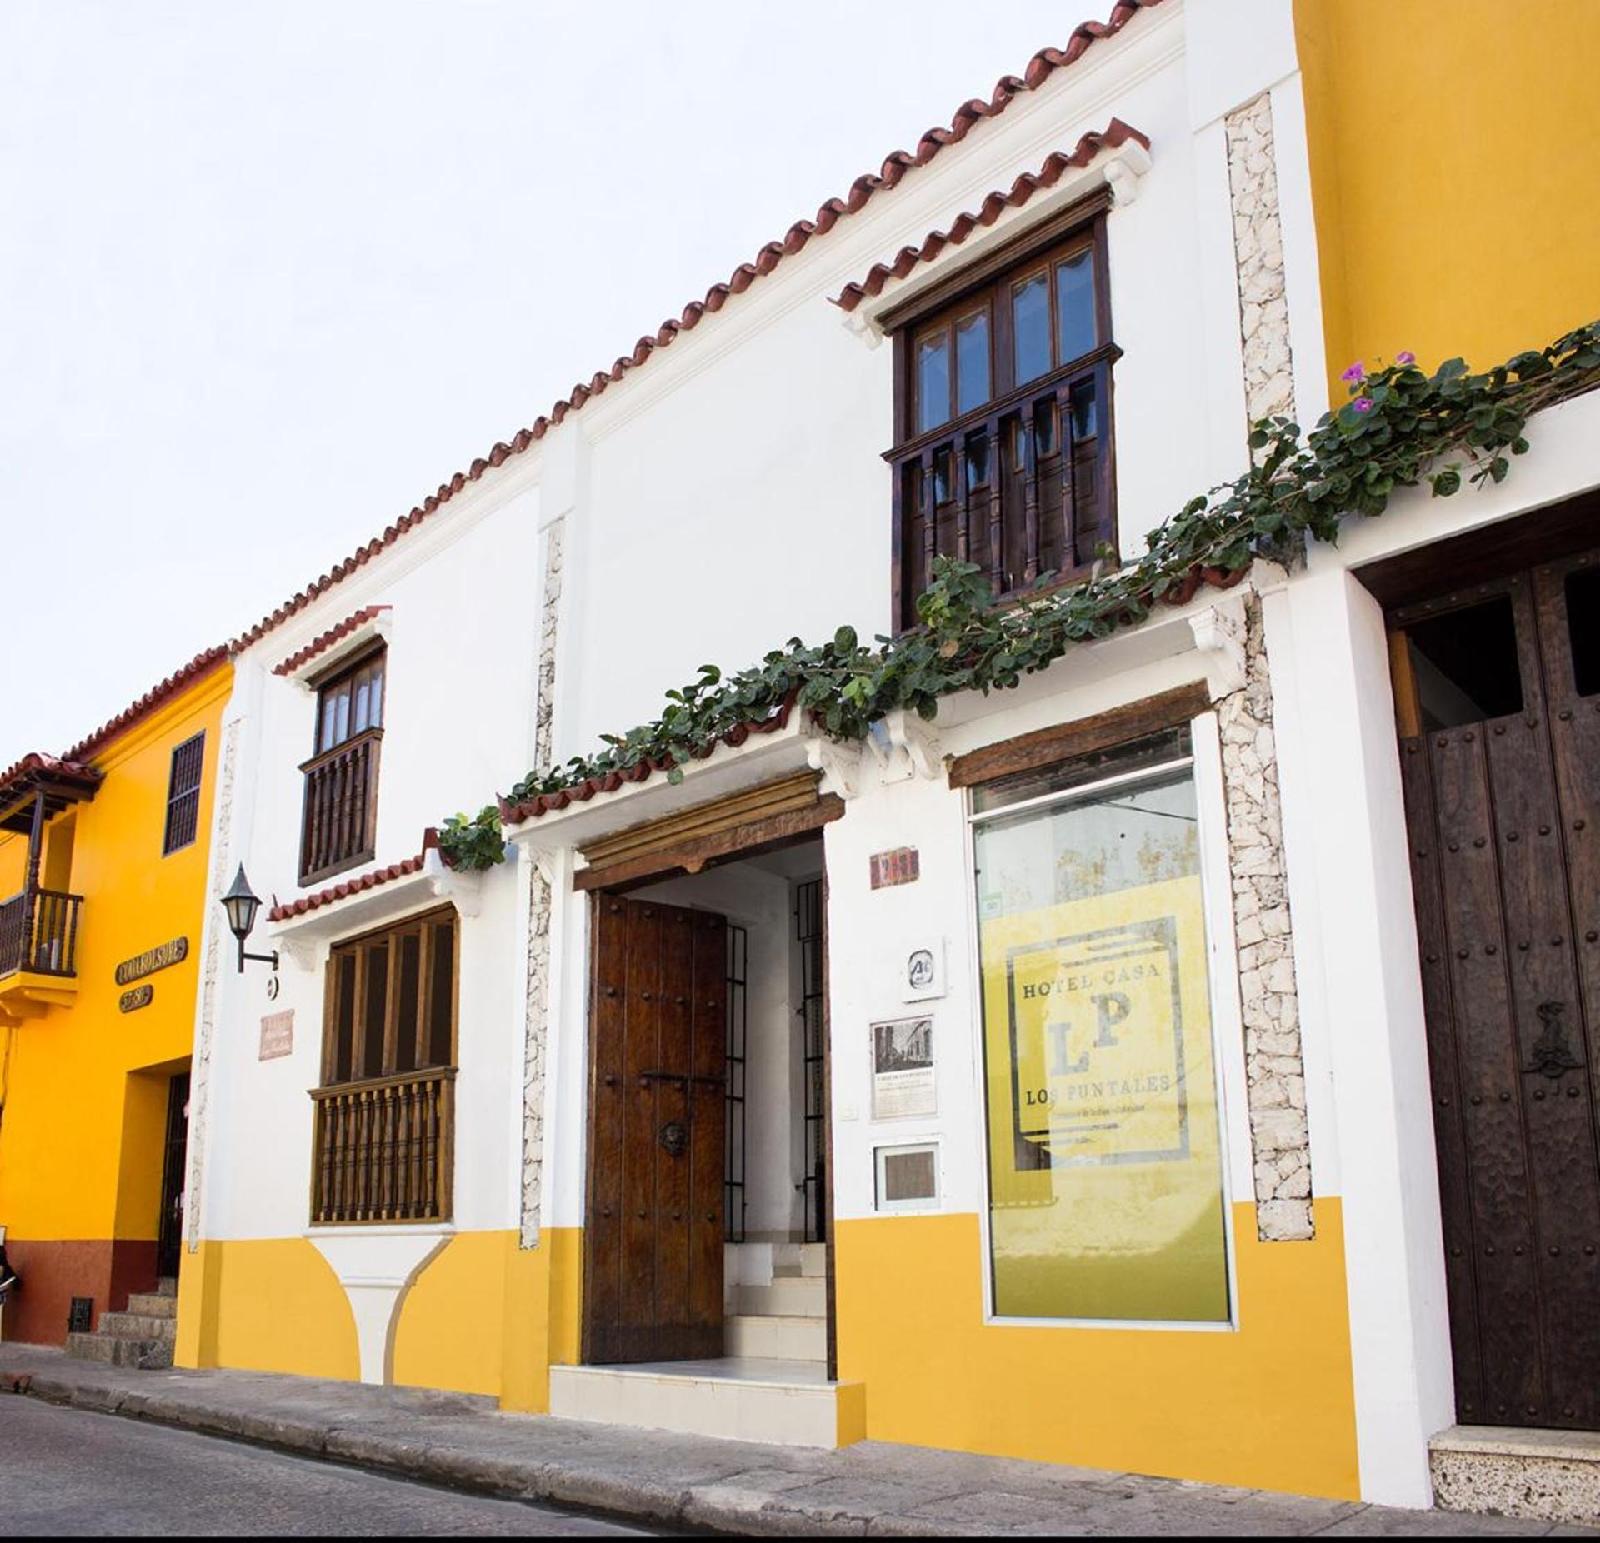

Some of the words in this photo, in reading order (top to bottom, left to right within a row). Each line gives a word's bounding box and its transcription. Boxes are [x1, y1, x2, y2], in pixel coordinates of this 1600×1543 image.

[1023, 976, 1092, 998] HOTEL
[1103, 964, 1160, 985] CASA
[1026, 1088, 1058, 1106] LOS
[1067, 1075, 1170, 1102] PUNTALES
